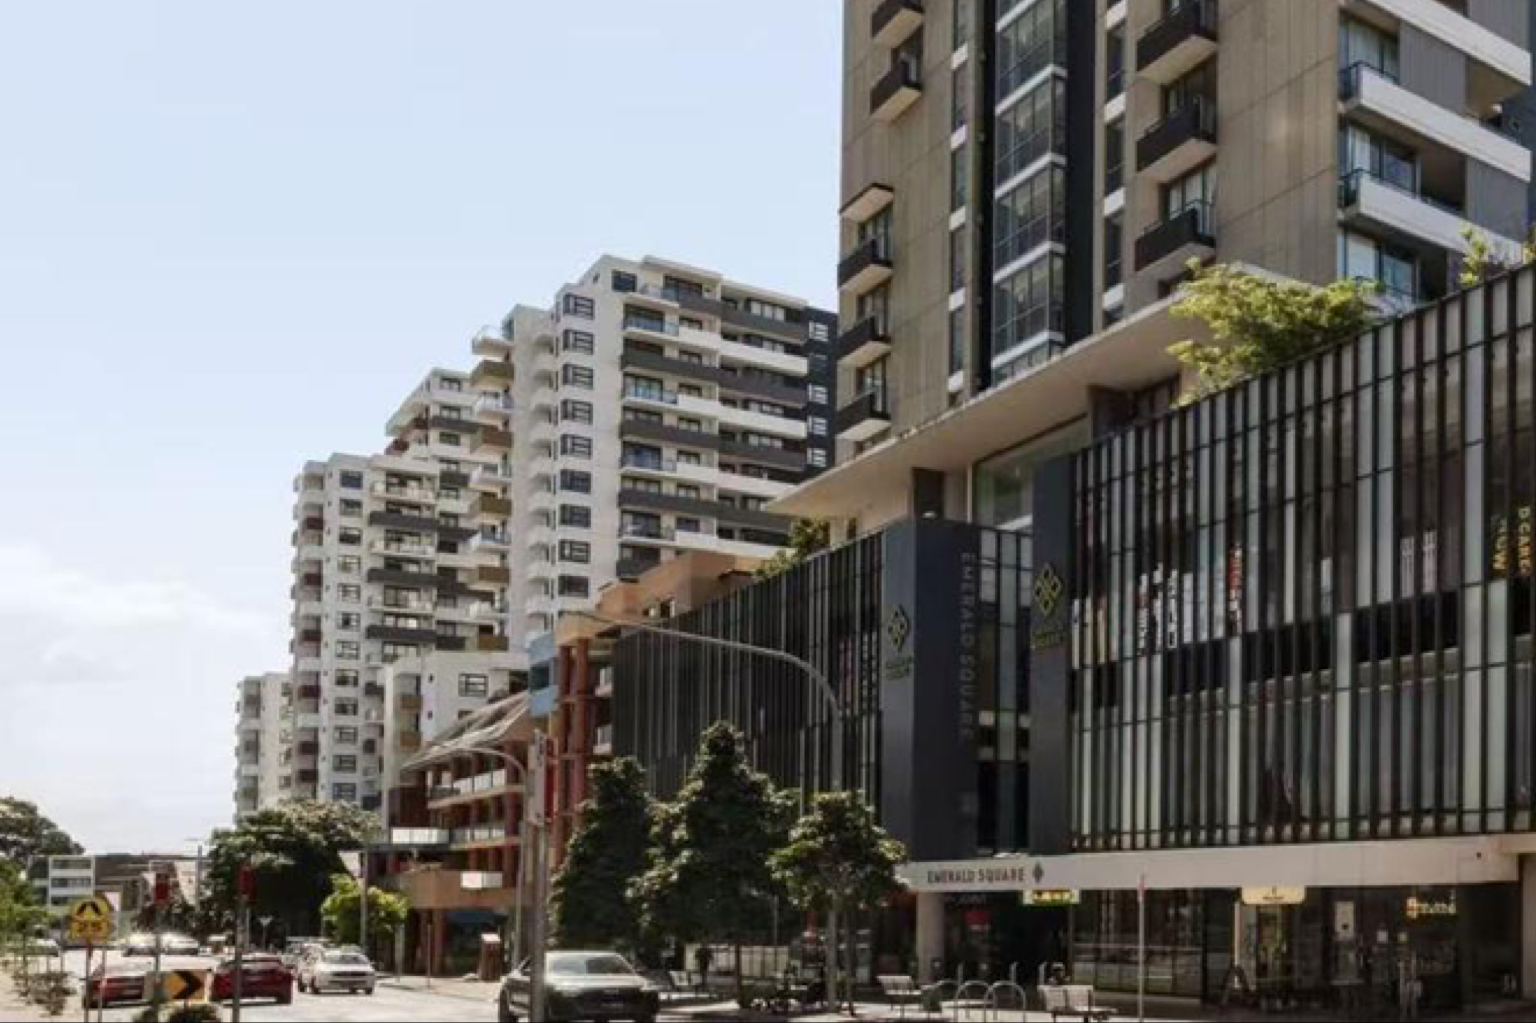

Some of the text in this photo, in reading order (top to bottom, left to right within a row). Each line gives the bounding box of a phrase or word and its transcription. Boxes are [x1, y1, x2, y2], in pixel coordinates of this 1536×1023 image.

[959, 552, 976, 646] EMERALD
[927, 867, 1025, 884] EMERALD SQUARE
